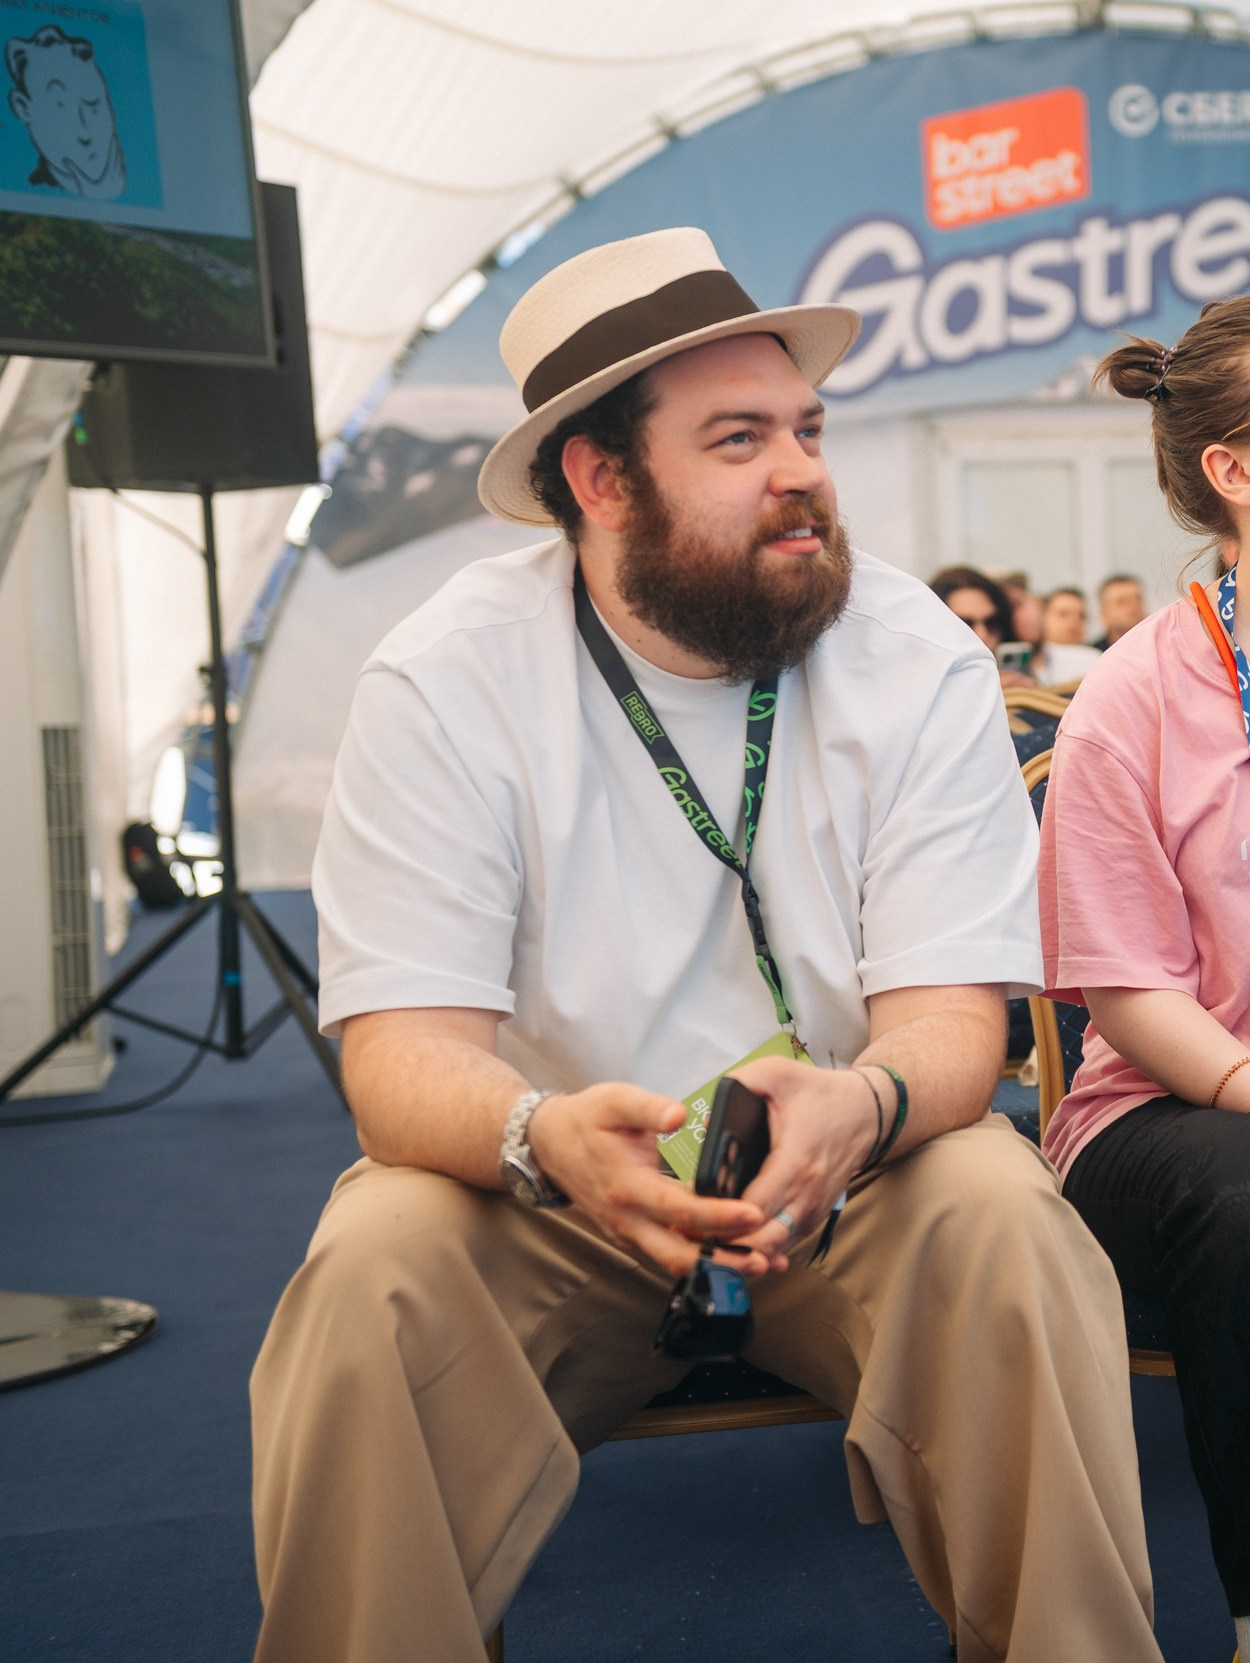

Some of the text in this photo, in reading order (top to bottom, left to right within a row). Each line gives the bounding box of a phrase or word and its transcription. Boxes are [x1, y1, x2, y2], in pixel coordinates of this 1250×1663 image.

[931, 131, 1018, 178] bar
[931, 150, 1082, 221] street
[626, 696, 657, 736] REBRO
